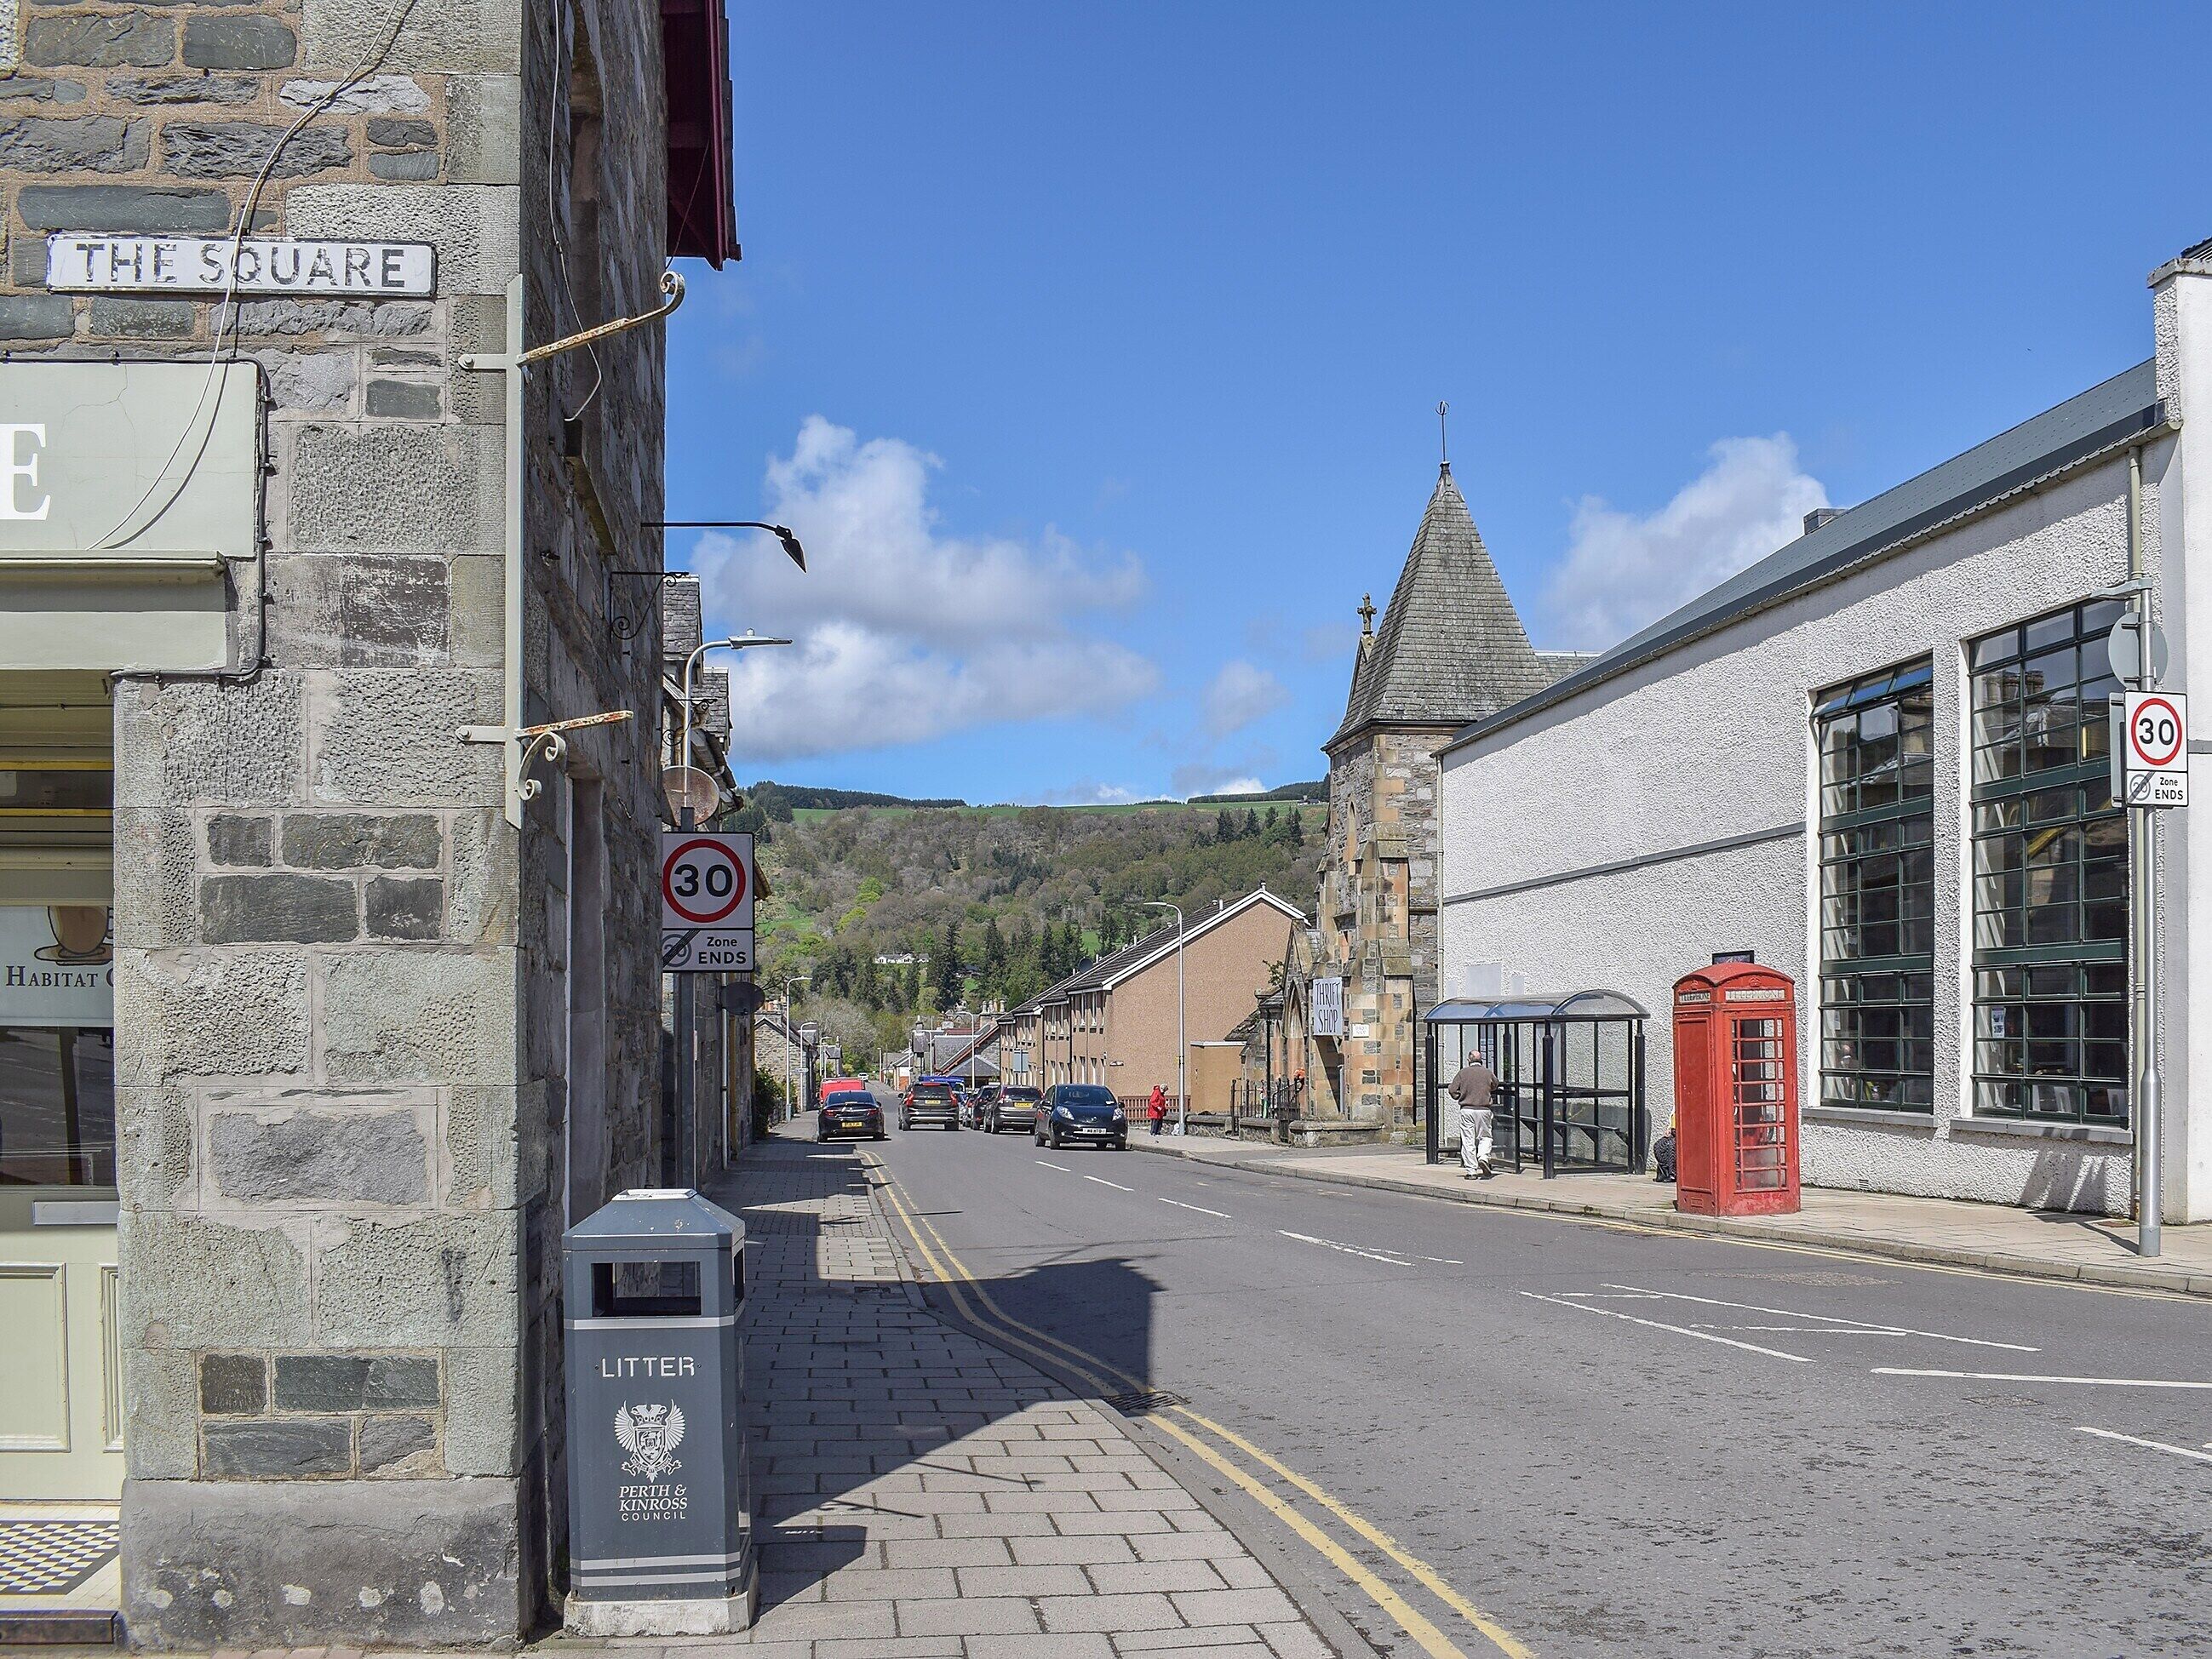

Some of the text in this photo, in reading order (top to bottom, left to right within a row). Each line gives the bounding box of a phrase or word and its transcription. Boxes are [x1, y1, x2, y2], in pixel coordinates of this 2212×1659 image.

[76, 242, 406, 289] THE SQUARE
[2139, 718, 2175, 746] 30
[2159, 777, 2179, 787] Zone
[2154, 789, 2184, 800] ENDS
[673, 863, 733, 897] 30
[706, 936, 738, 947] Zone
[697, 952, 747, 964] ENDS
[5, 965, 99, 987] HABITAT
[1315, 981, 1341, 1007] THRIFT
[1681, 992, 1710, 1002] TELEPHONE
[1727, 990, 1783, 999] TELEPHONE
[1318, 1009, 1338, 1033] SHOP
[601, 1356, 696, 1377] LITTER
[618, 1484, 687, 1498] PERTH &
[618, 1497, 688, 1512] KINROSS
[622, 1511, 686, 1522] COUNCIL
